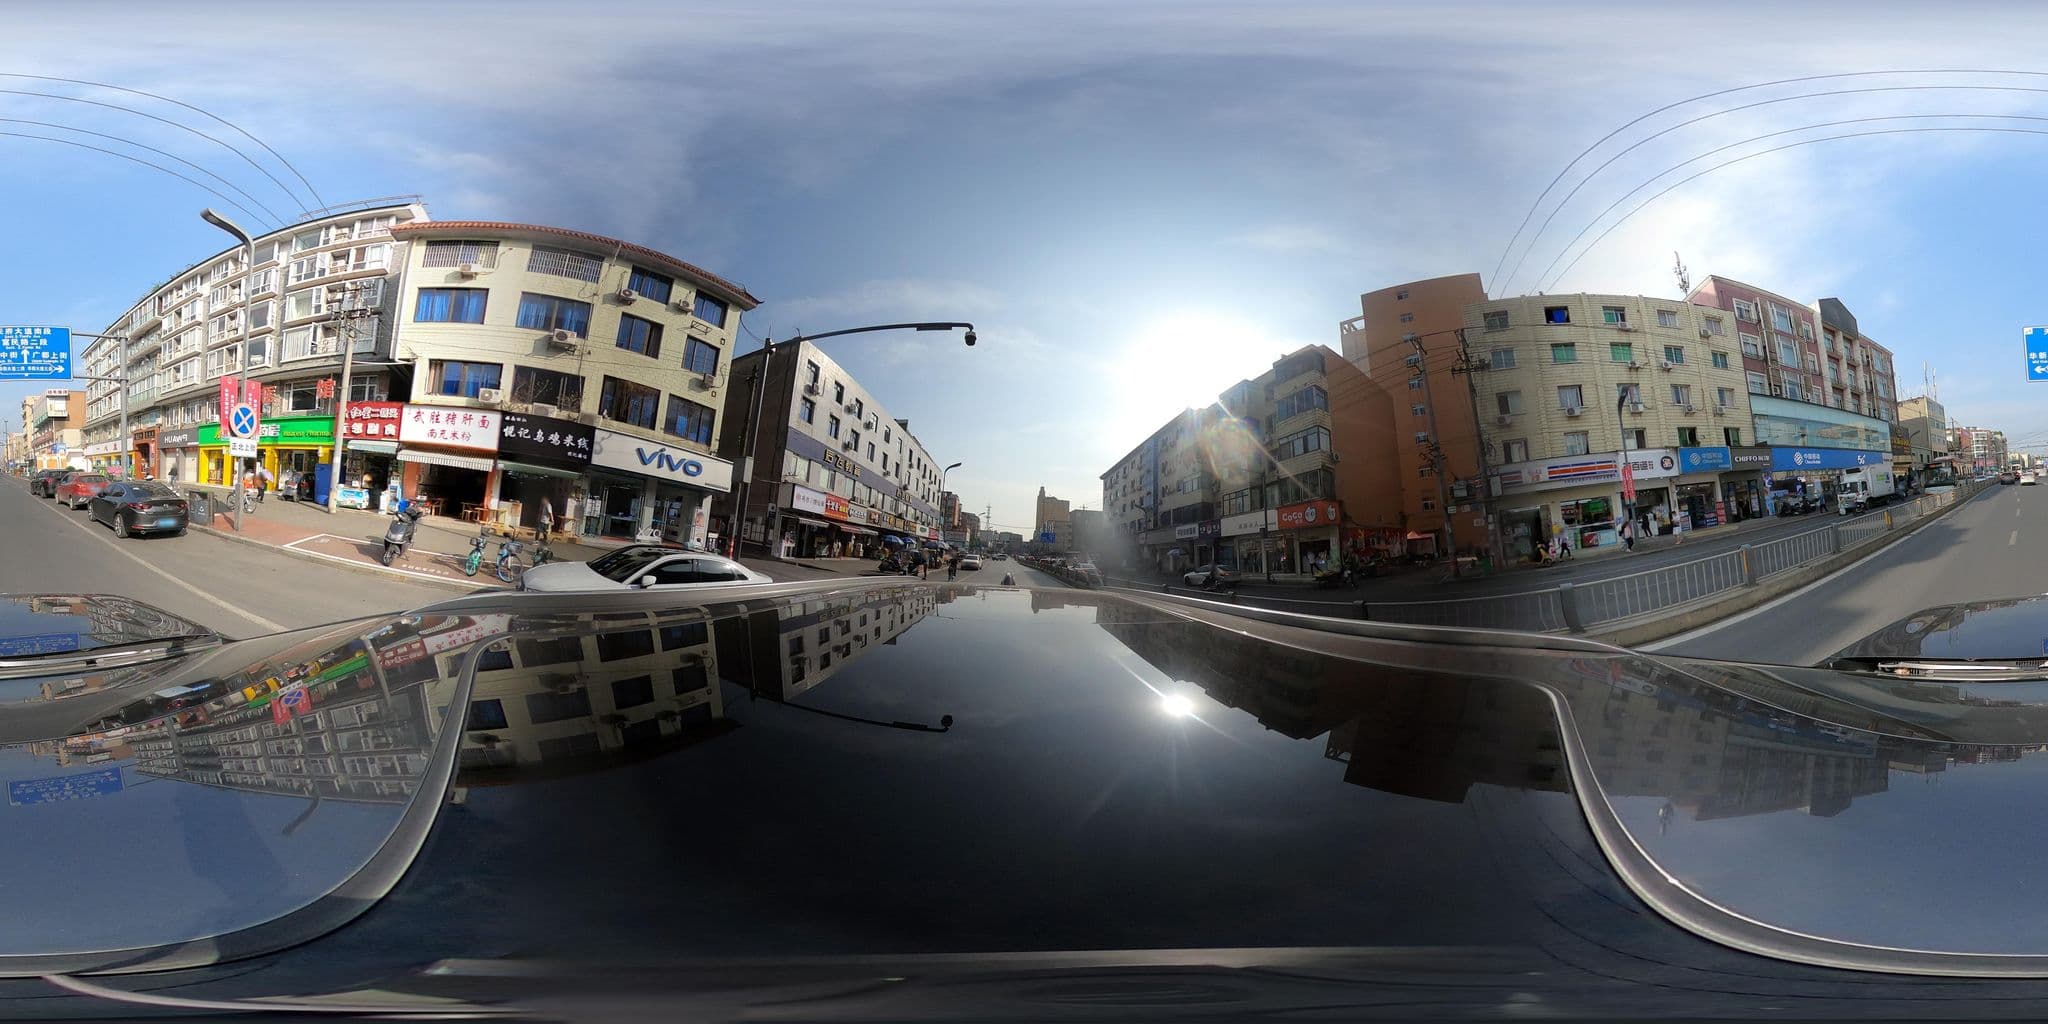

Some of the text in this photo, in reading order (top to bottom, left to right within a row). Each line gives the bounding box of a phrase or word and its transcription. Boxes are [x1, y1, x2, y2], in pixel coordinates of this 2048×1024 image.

[414, 410, 490, 430] 武胜猪肝面
[636, 447, 704, 477] vivo
[1282, 511, 1302, 521] CoCo
